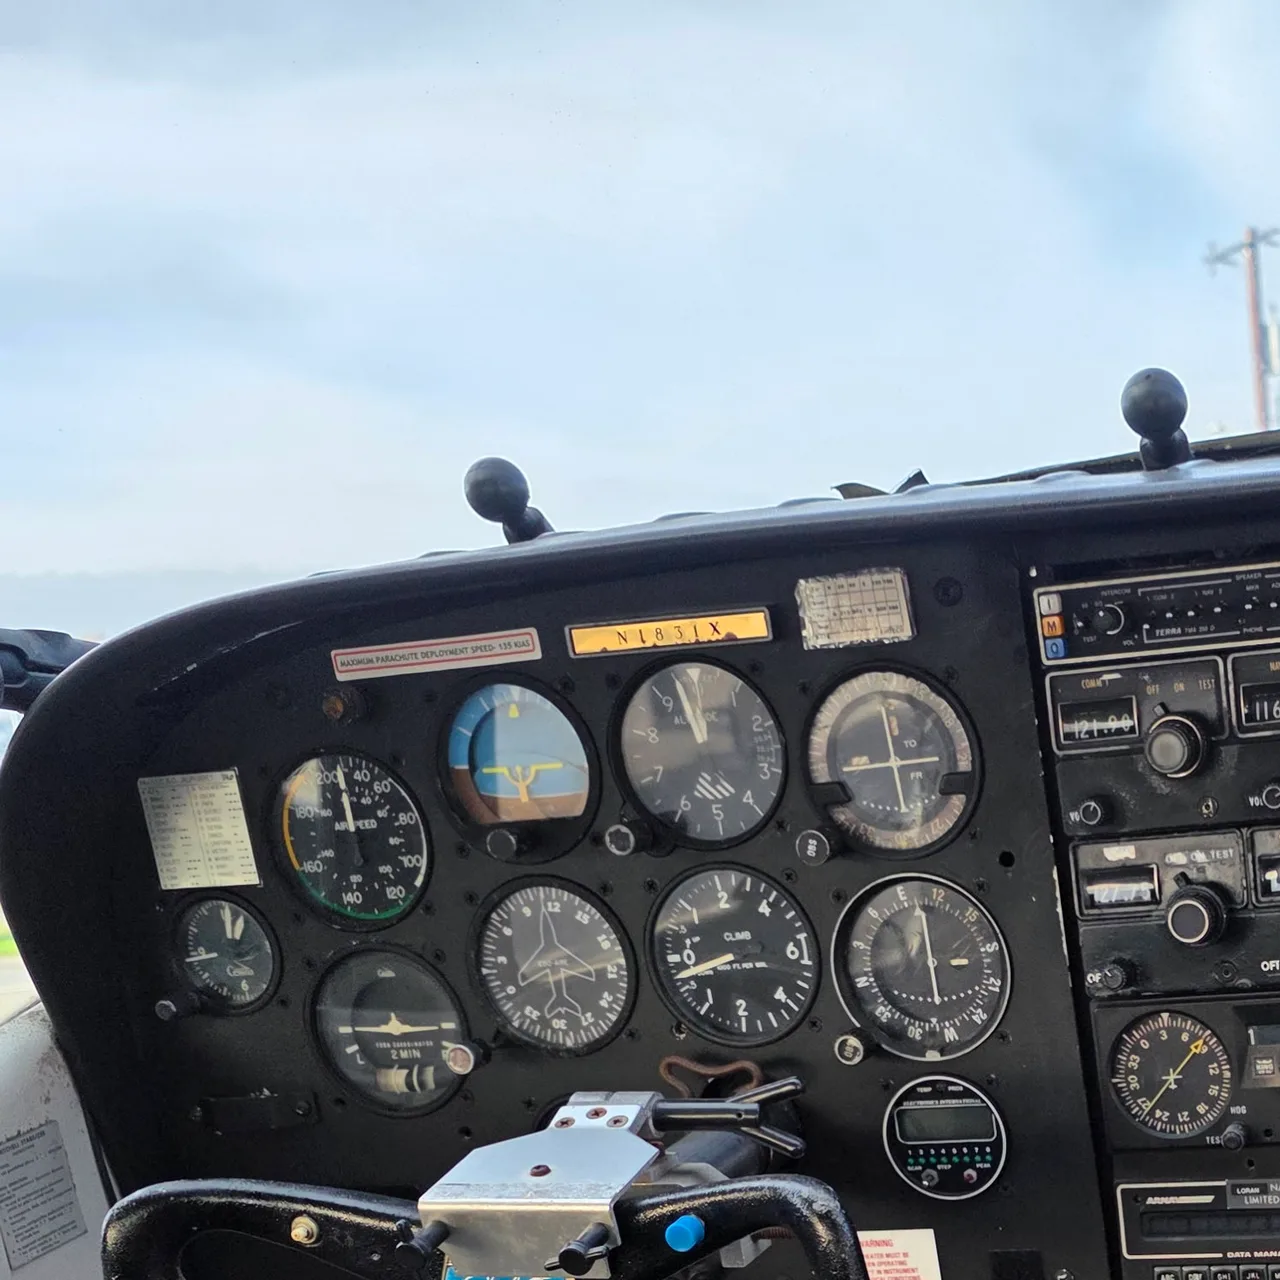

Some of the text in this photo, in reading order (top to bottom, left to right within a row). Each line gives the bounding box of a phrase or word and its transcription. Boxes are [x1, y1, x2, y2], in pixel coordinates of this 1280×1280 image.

[1236, 572, 1262, 580] SPEAKER
[1155, 627, 1181, 637] TERRA
[340, 640, 530, 668] MAXIMUM PARACHUTE DEPLOYMENT KIAS
[1146, 679, 1215, 695] OFF TEST
[1210, 849, 1234, 859] TEST
[1236, 1186, 1260, 1194] LORAN
[1244, 1194, 1280, 1205] LIMITED
